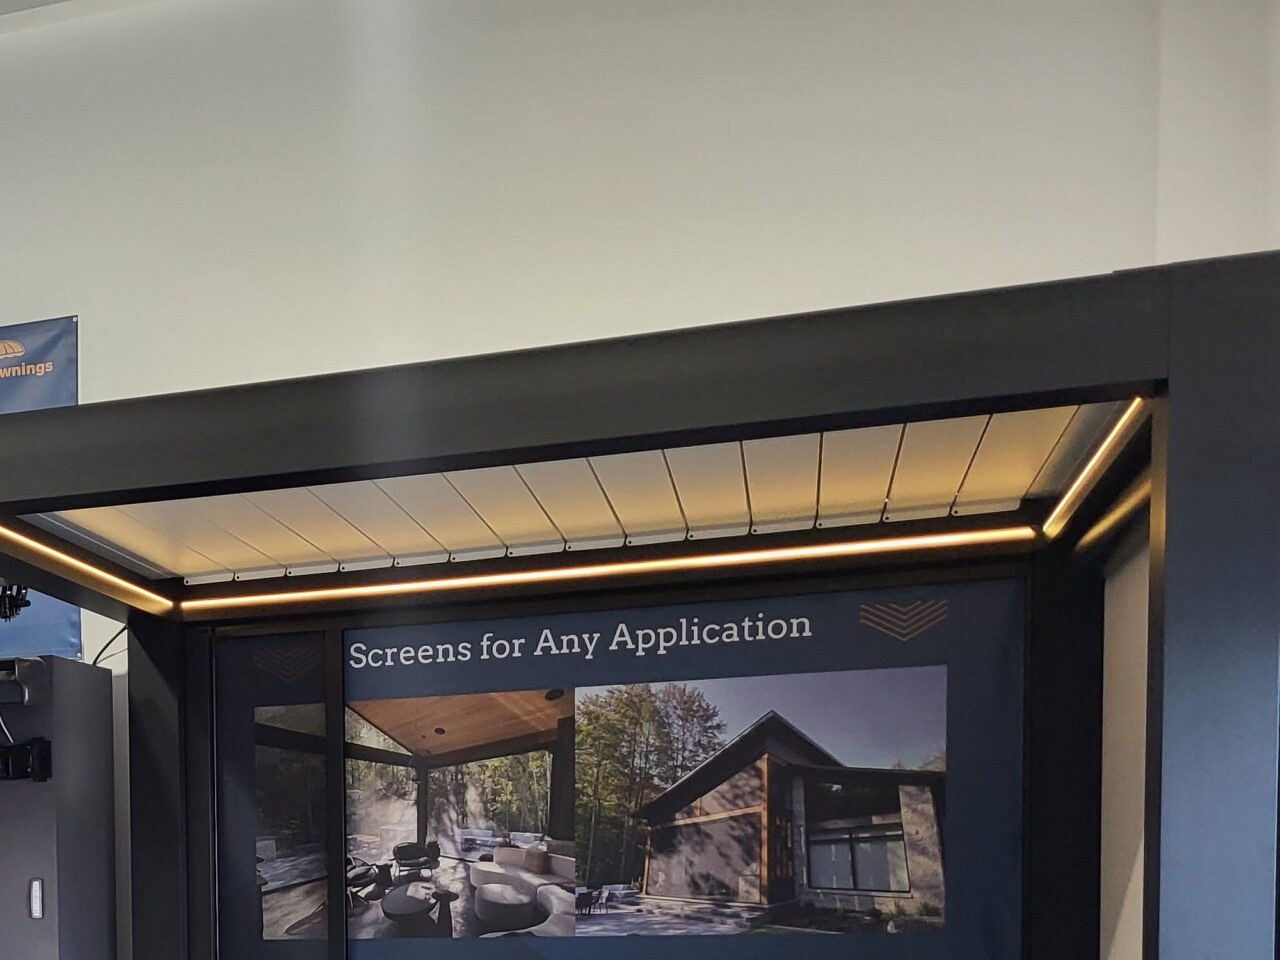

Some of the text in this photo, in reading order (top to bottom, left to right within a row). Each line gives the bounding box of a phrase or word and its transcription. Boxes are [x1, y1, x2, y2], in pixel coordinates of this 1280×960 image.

[348, 612, 813, 670] Screens for Any Application
